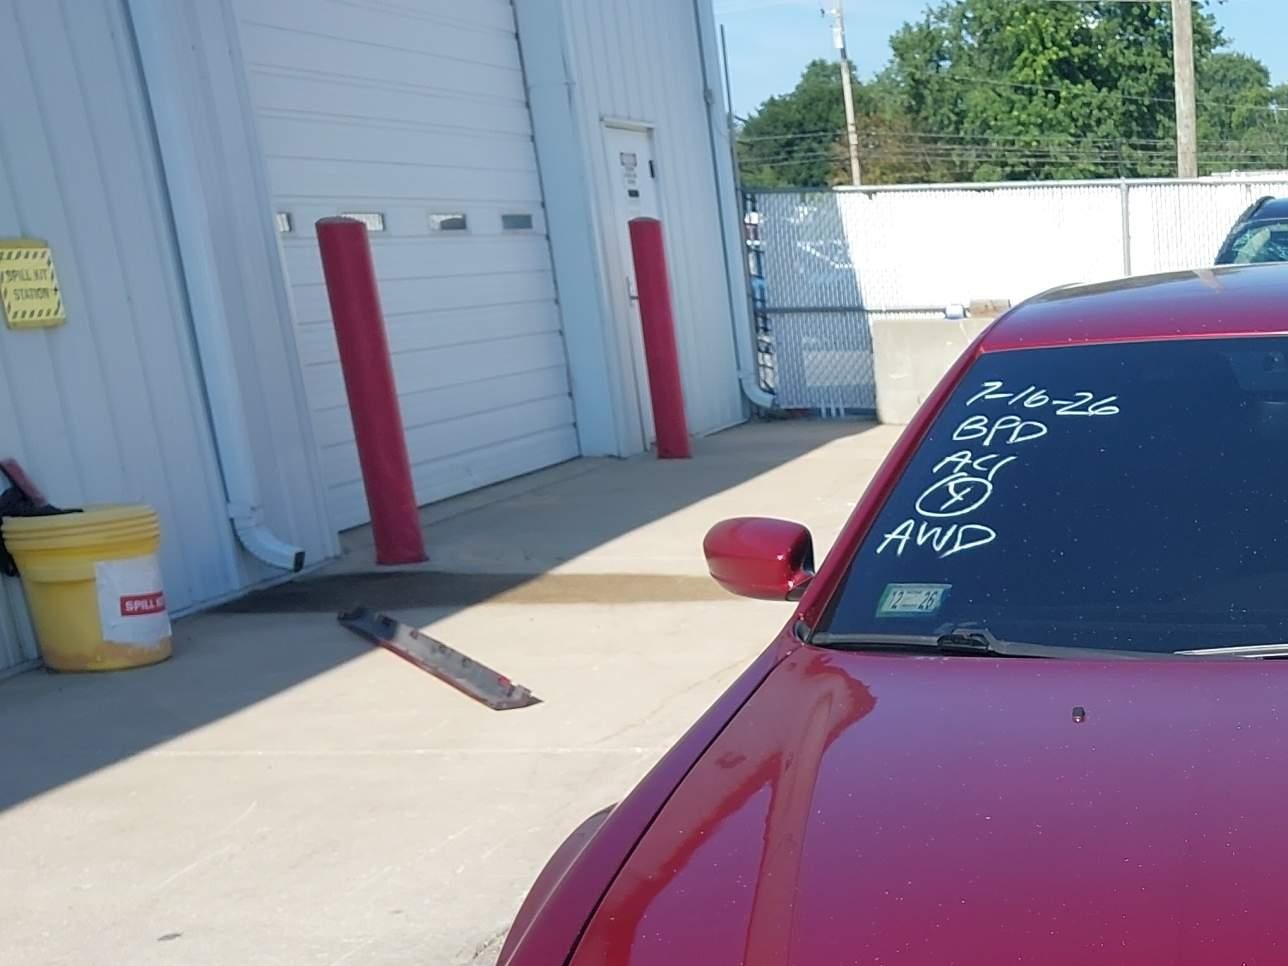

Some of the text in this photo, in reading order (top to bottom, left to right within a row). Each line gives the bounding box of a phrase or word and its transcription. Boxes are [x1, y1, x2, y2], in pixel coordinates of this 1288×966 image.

[5, 268, 48, 282] SPILL KIT
[13, 287, 50, 301] STATION
[966, 381, 1120, 416] 7-16-26
[952, 415, 1048, 447] BPD
[876, 519, 996, 558] AWD
[125, 598, 155, 612] SPILL
[889, 590, 938, 610] 12 26
